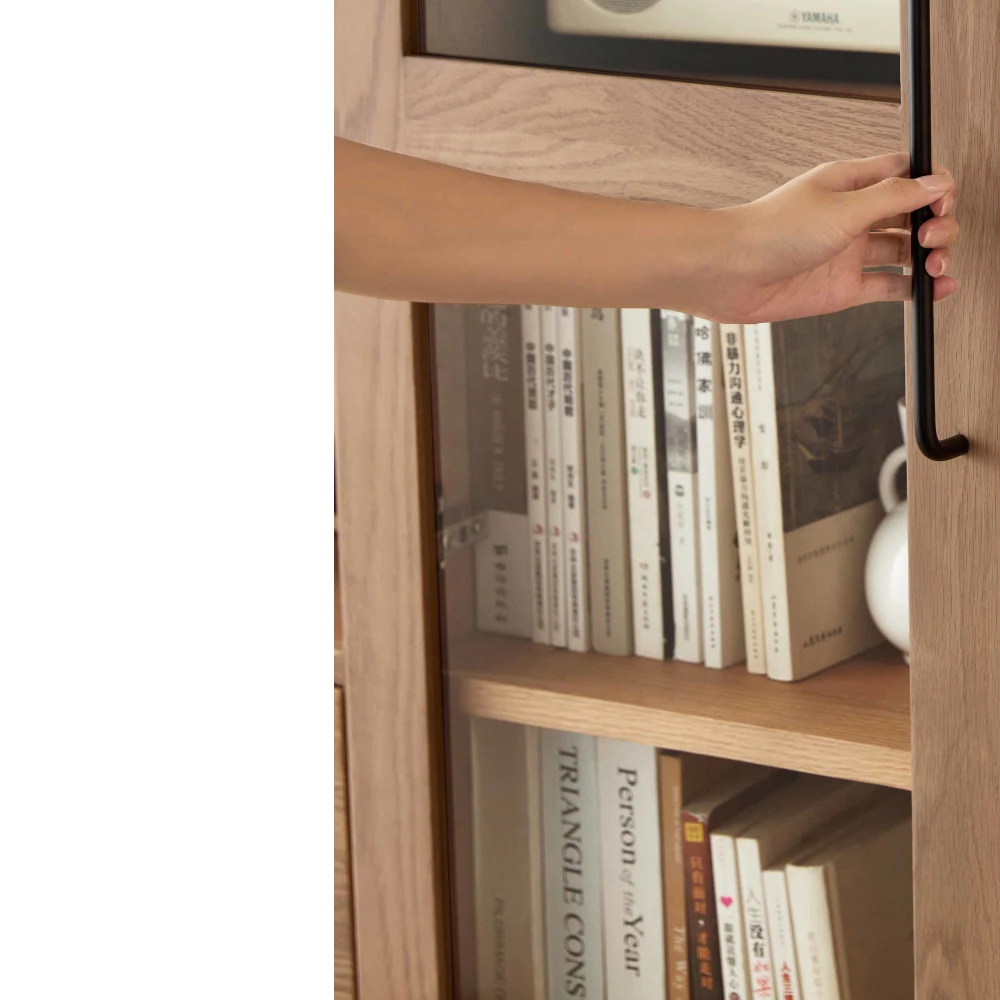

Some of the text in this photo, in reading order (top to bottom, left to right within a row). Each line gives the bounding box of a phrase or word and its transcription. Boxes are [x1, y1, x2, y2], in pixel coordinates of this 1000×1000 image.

[801, 11, 840, 25] YAMAHA
[725, 332, 746, 449] 非暴力沟通心理学
[557, 745, 585, 907] TRIANGLE
[616, 766, 646, 978] Person of the Year
[672, 926, 688, 991] The Way
